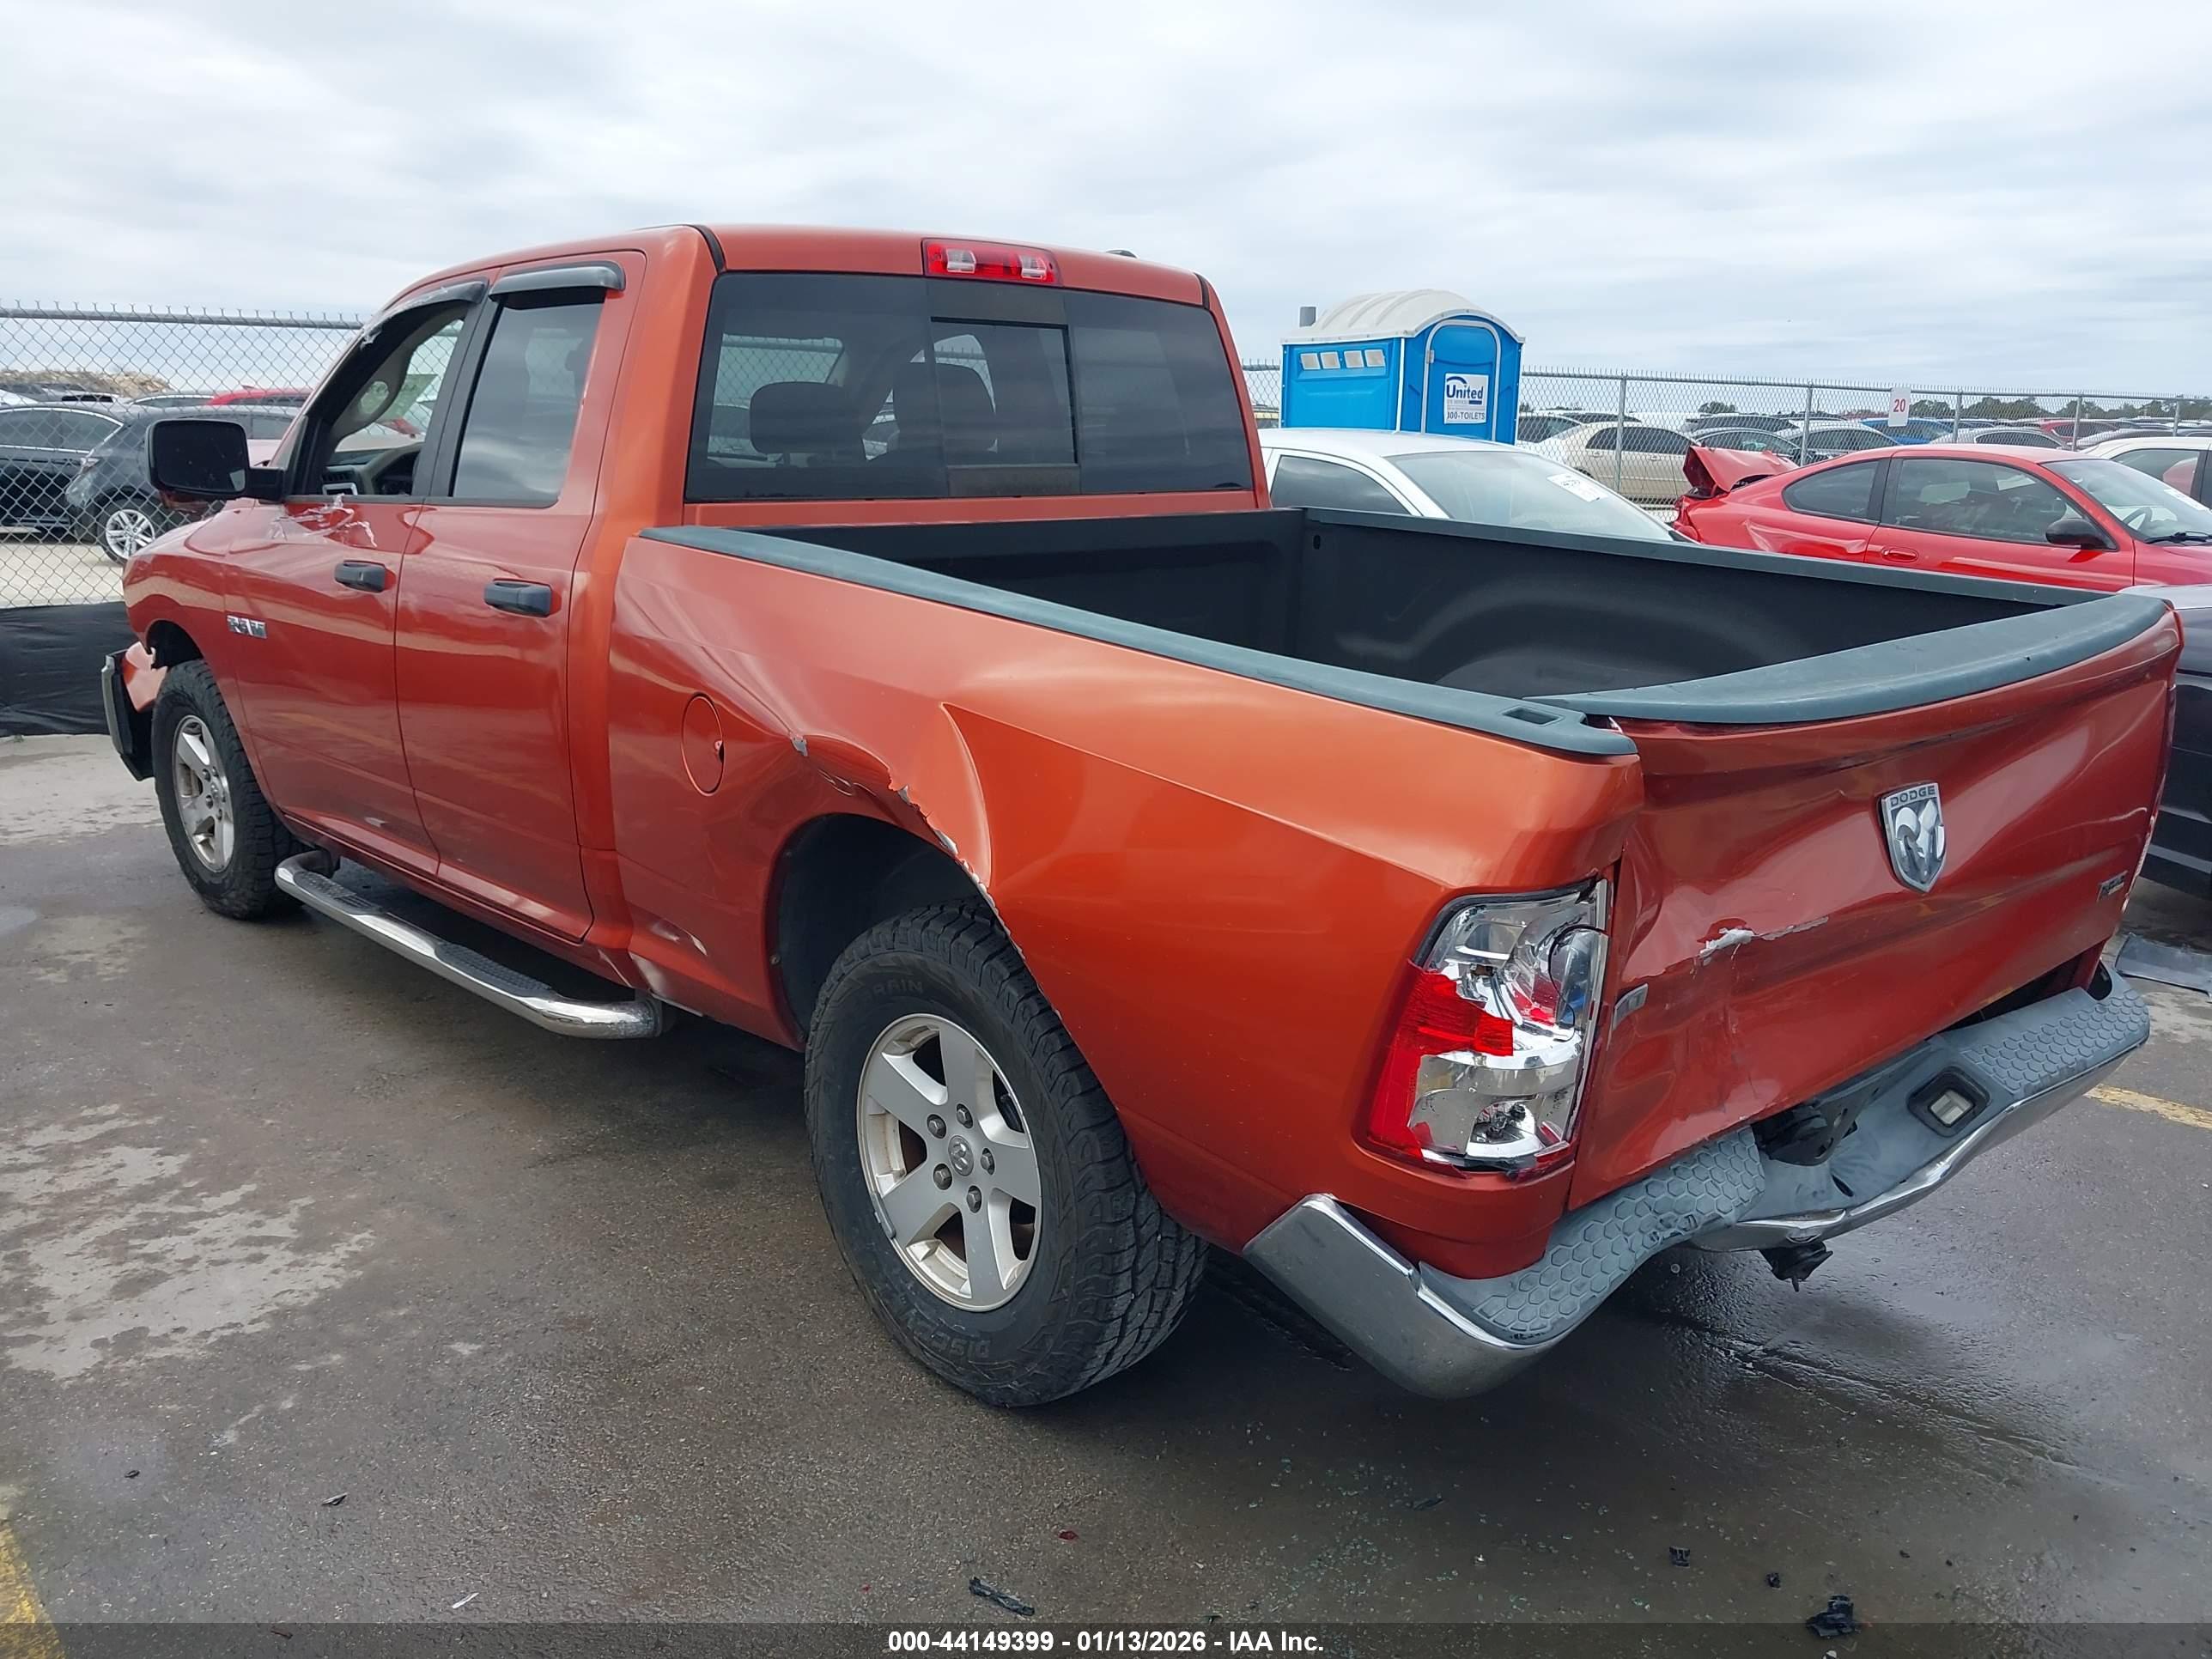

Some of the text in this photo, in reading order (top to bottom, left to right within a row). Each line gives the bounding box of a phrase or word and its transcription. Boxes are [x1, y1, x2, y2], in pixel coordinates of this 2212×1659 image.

[1446, 384, 1484, 399] United
[1893, 398, 1906, 412] 20
[1890, 785, 1937, 807] DODGE
